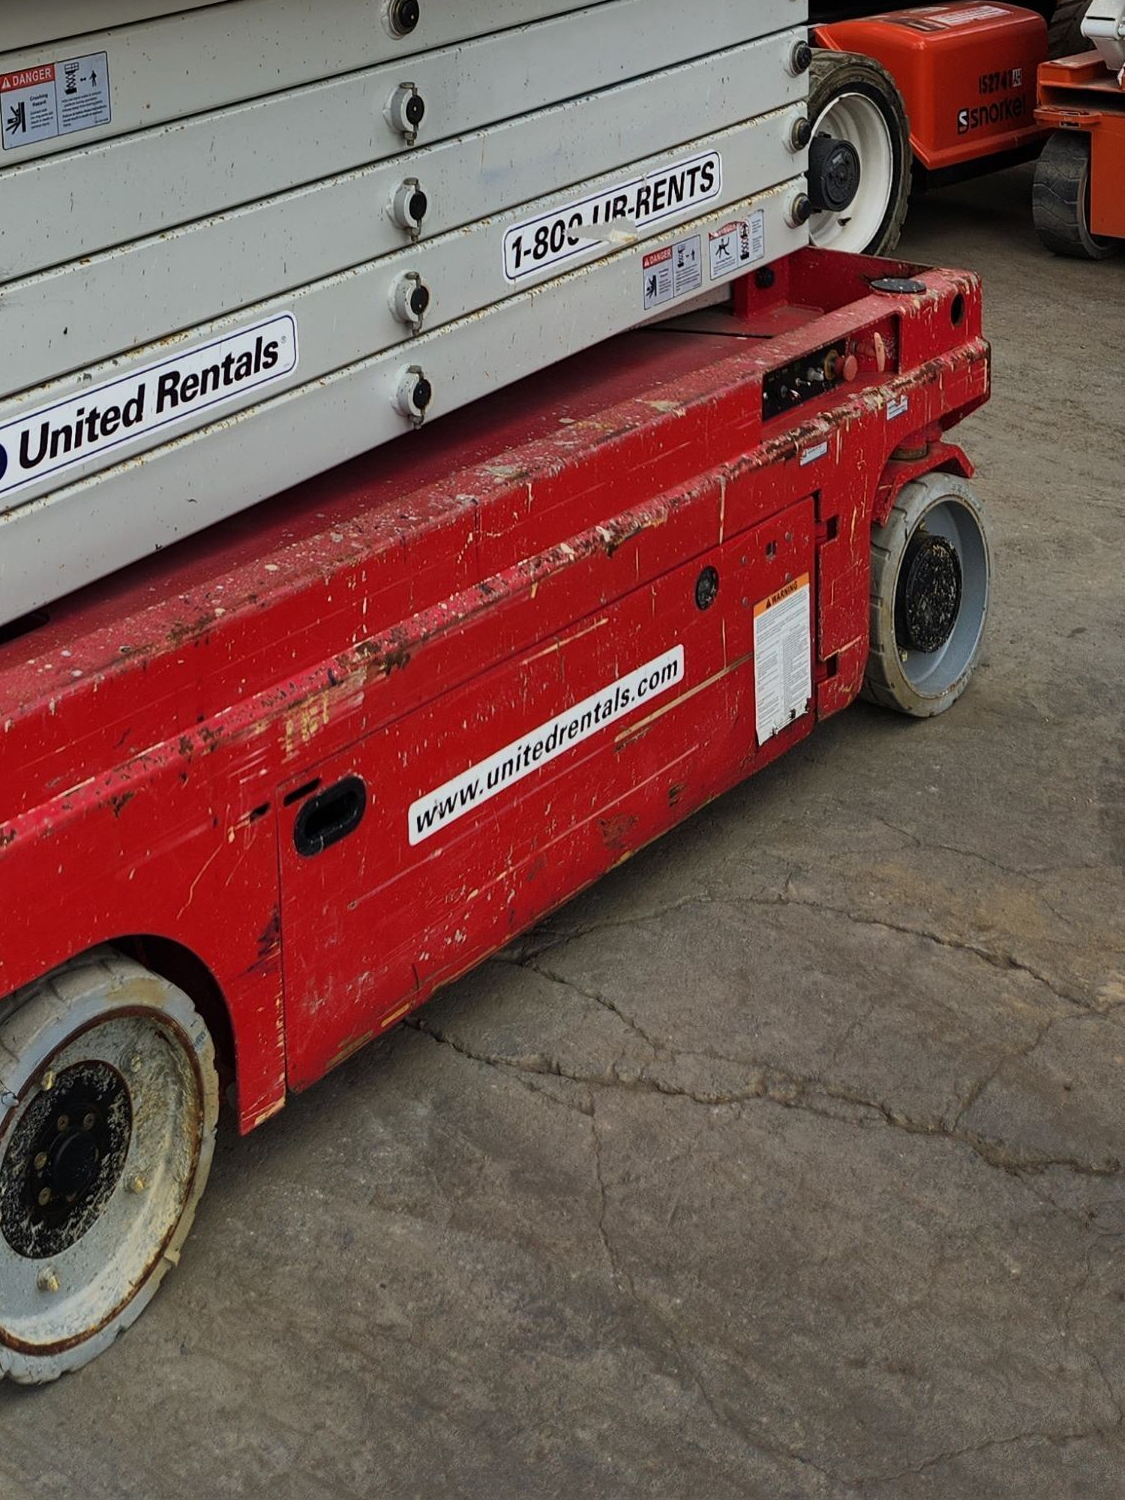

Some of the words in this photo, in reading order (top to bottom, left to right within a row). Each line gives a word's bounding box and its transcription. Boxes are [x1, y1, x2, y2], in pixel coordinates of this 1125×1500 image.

[11, 67, 52, 87] DANGER
[969, 97, 1025, 129] snorkel
[649, 249, 672, 264] DANGER
[18, 383, 146, 470] United
[155, 335, 280, 415] Rentals
[771, 580, 799, 607] WARNING
[415, 656, 679, 834] www.unitedrentals.com
